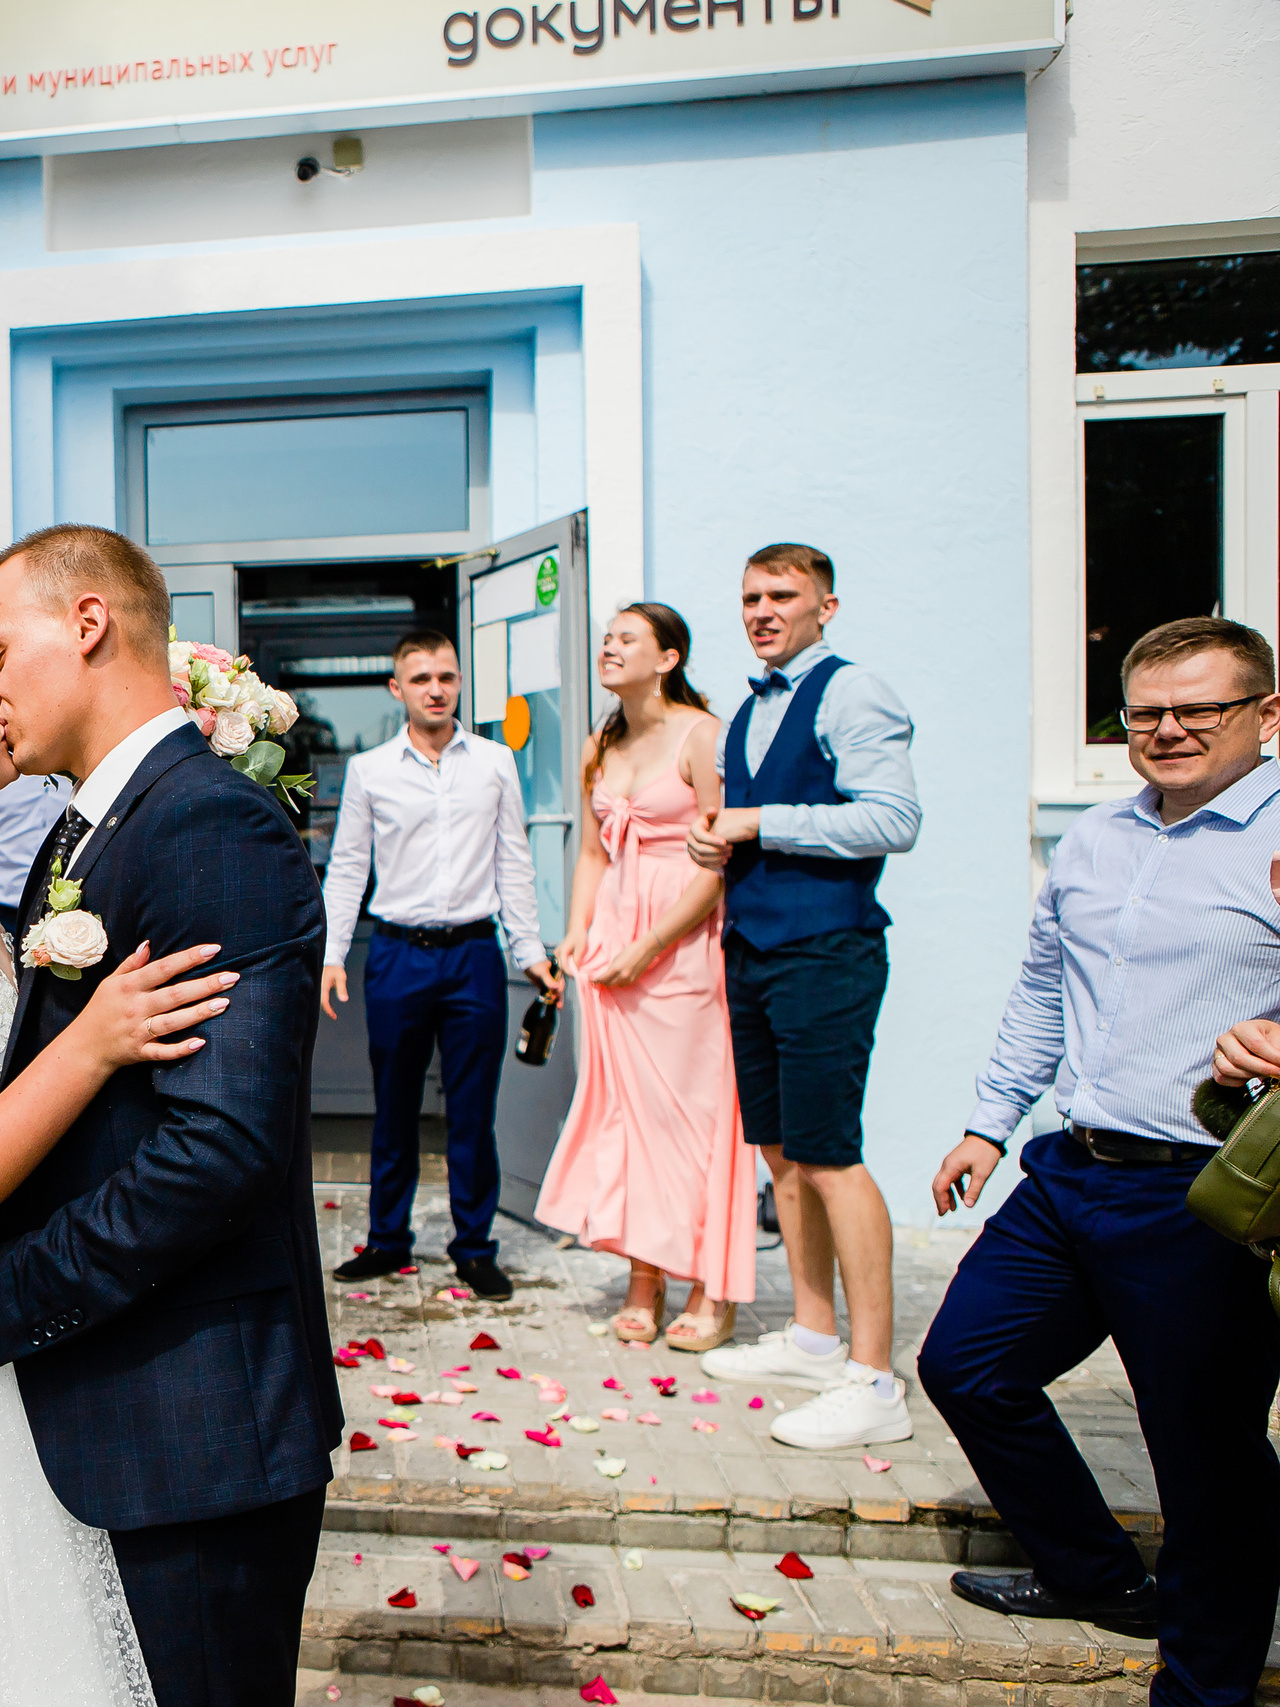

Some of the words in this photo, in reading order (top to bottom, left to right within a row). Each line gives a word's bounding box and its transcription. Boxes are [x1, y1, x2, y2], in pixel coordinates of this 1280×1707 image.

[3, 73, 17, 95] и
[28, 50, 253, 98] муниципальных
[263, 42, 337, 77] услуг
